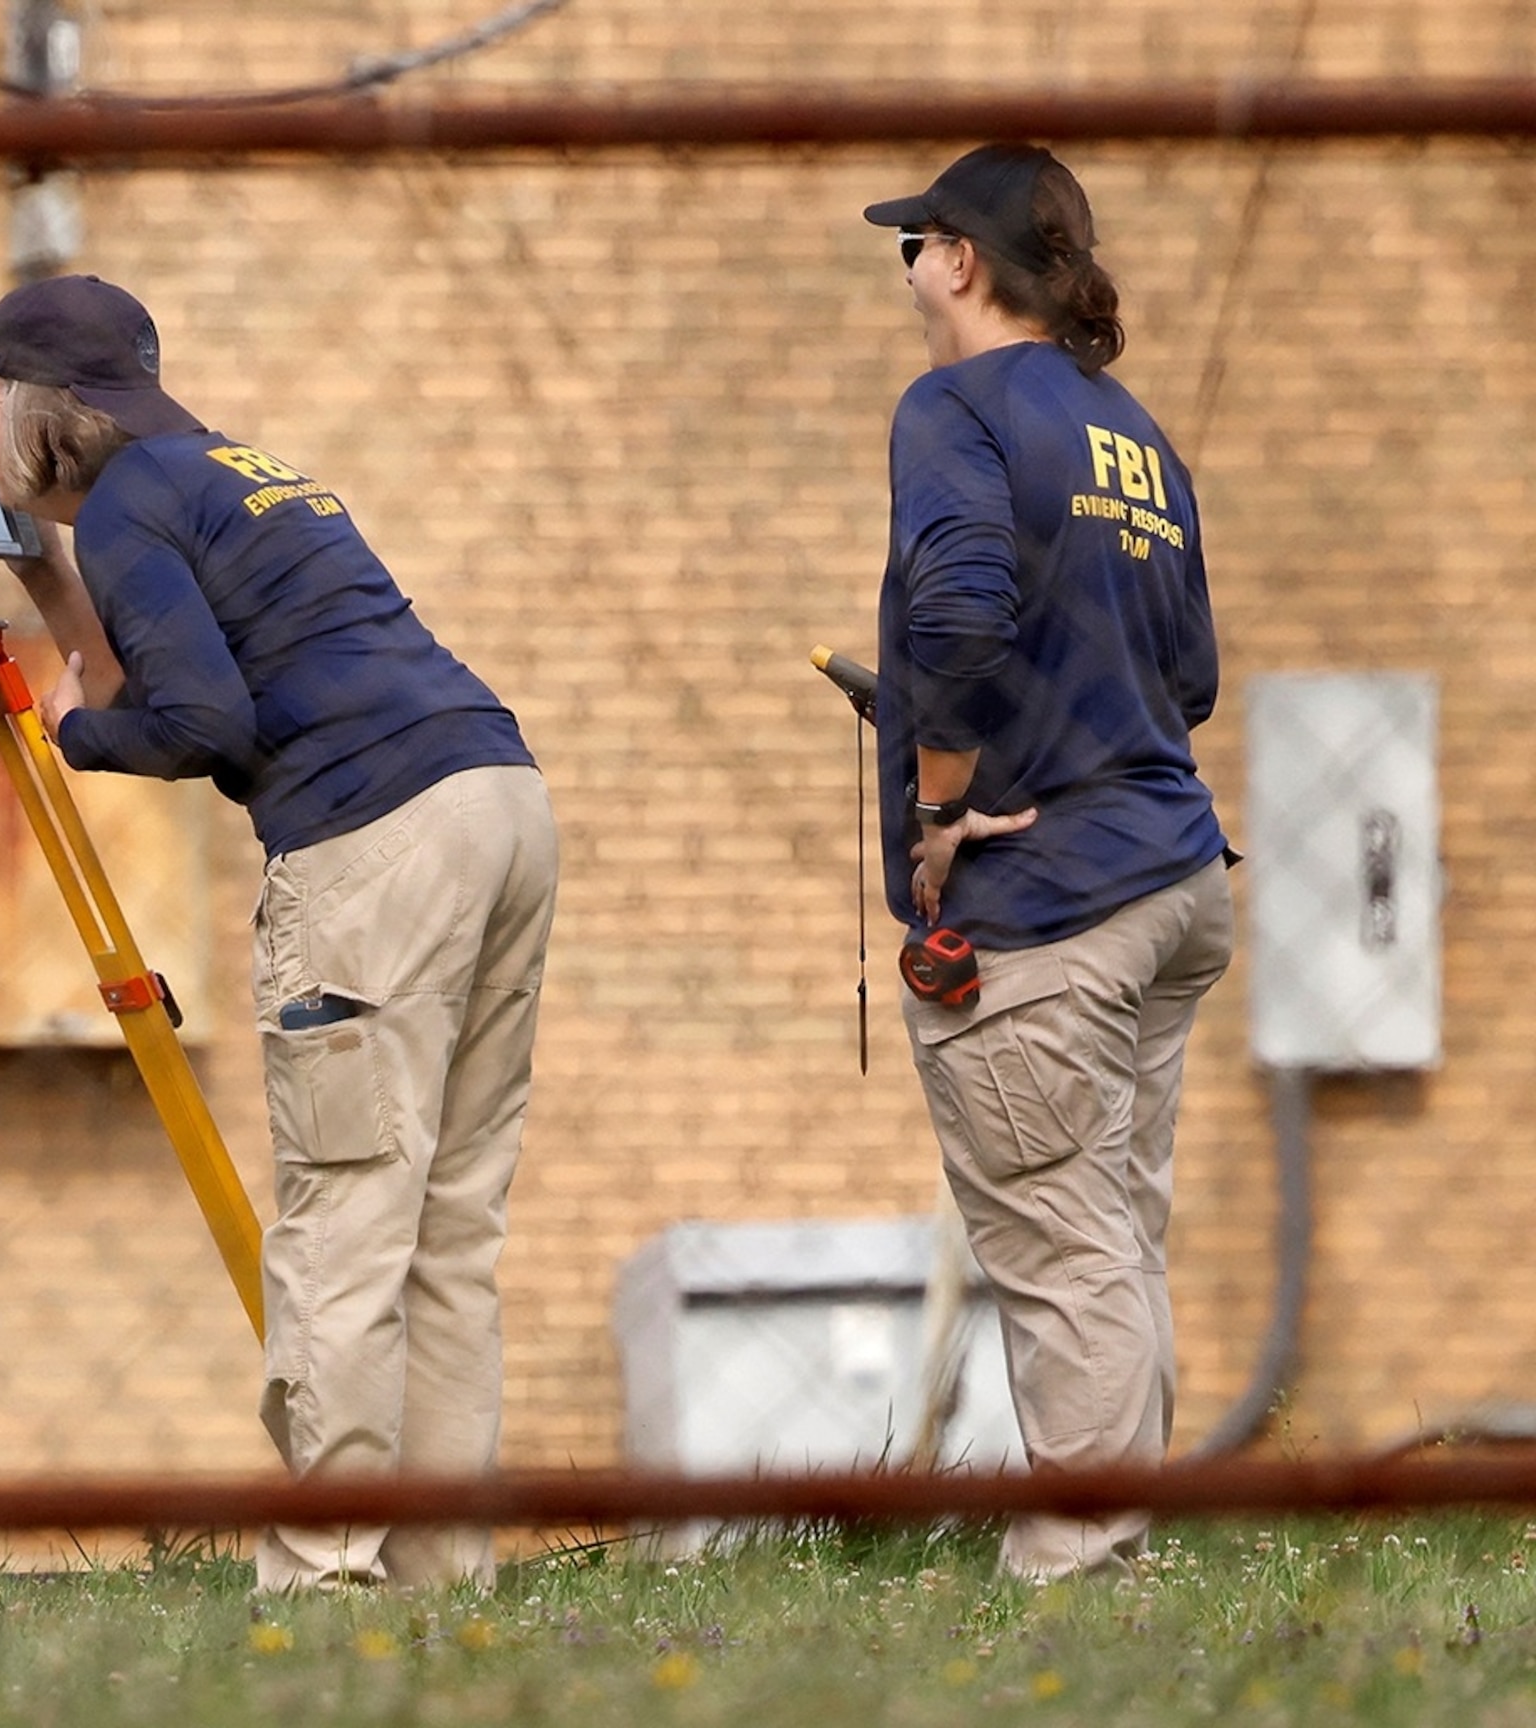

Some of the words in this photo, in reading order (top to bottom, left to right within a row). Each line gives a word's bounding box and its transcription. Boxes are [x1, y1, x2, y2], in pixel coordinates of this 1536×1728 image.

[206, 446, 300, 484] FB
[1085, 424, 1167, 511] FBI
[1118, 528, 1151, 561] TAM
